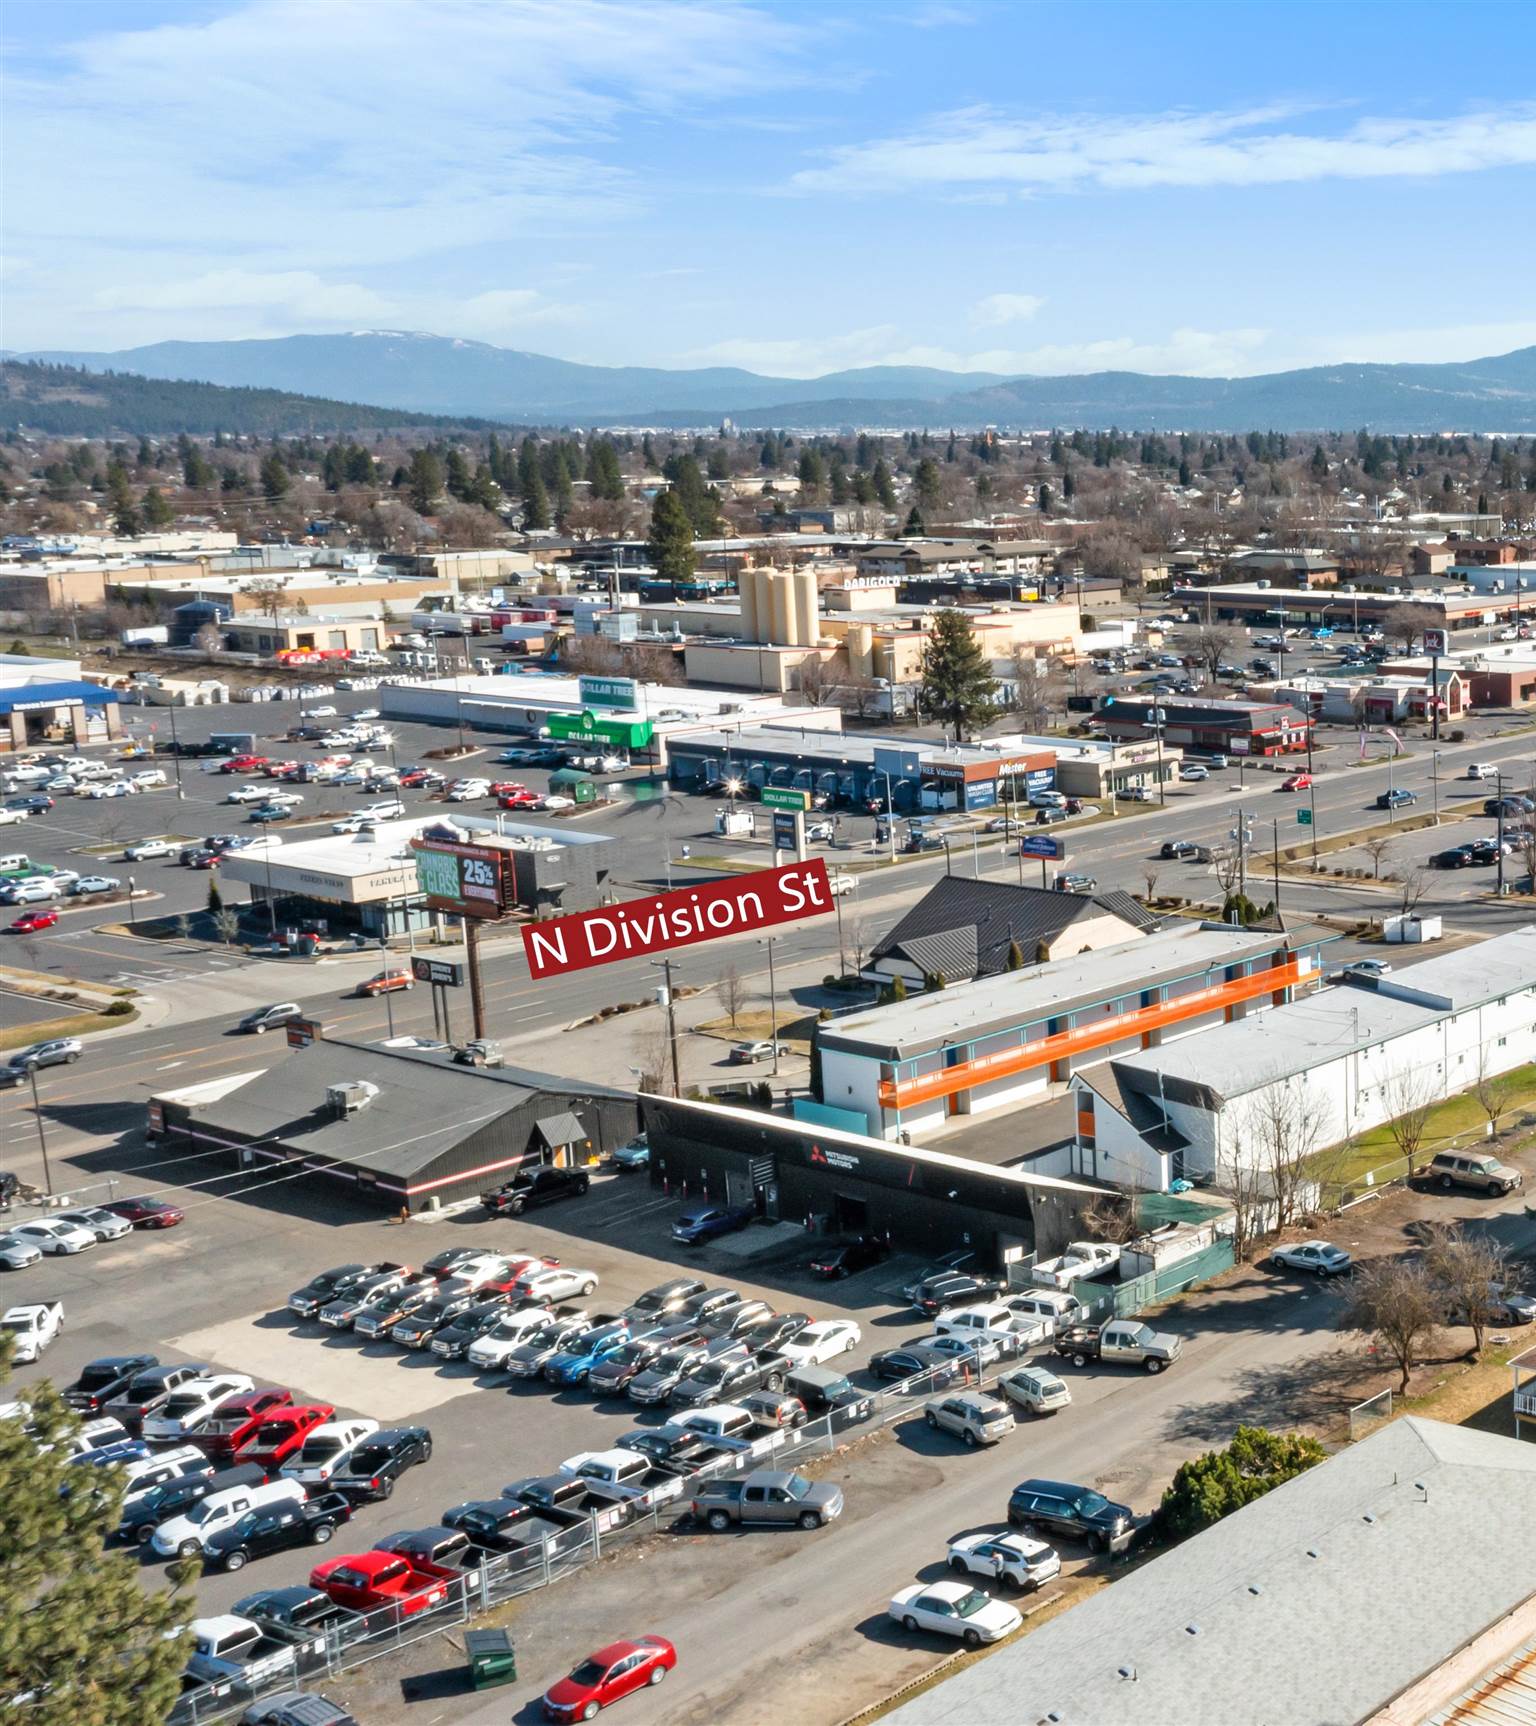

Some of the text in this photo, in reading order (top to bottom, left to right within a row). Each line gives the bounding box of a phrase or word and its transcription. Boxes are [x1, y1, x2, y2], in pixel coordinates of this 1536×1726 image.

[844, 575, 901, 590] DARIGOLD
[580, 682, 633, 697] DOLLAR TREE
[568, 731, 611, 743] DOLLAR TREE
[920, 765, 936, 776] FREE
[764, 793, 804, 805] DOLLAR TREE
[416, 850, 459, 875] CANNABIS
[426, 870, 460, 898] GLASS
[825, 1150, 860, 1165] MITSUBISHI
[827, 1158, 853, 1170] MOTORS
